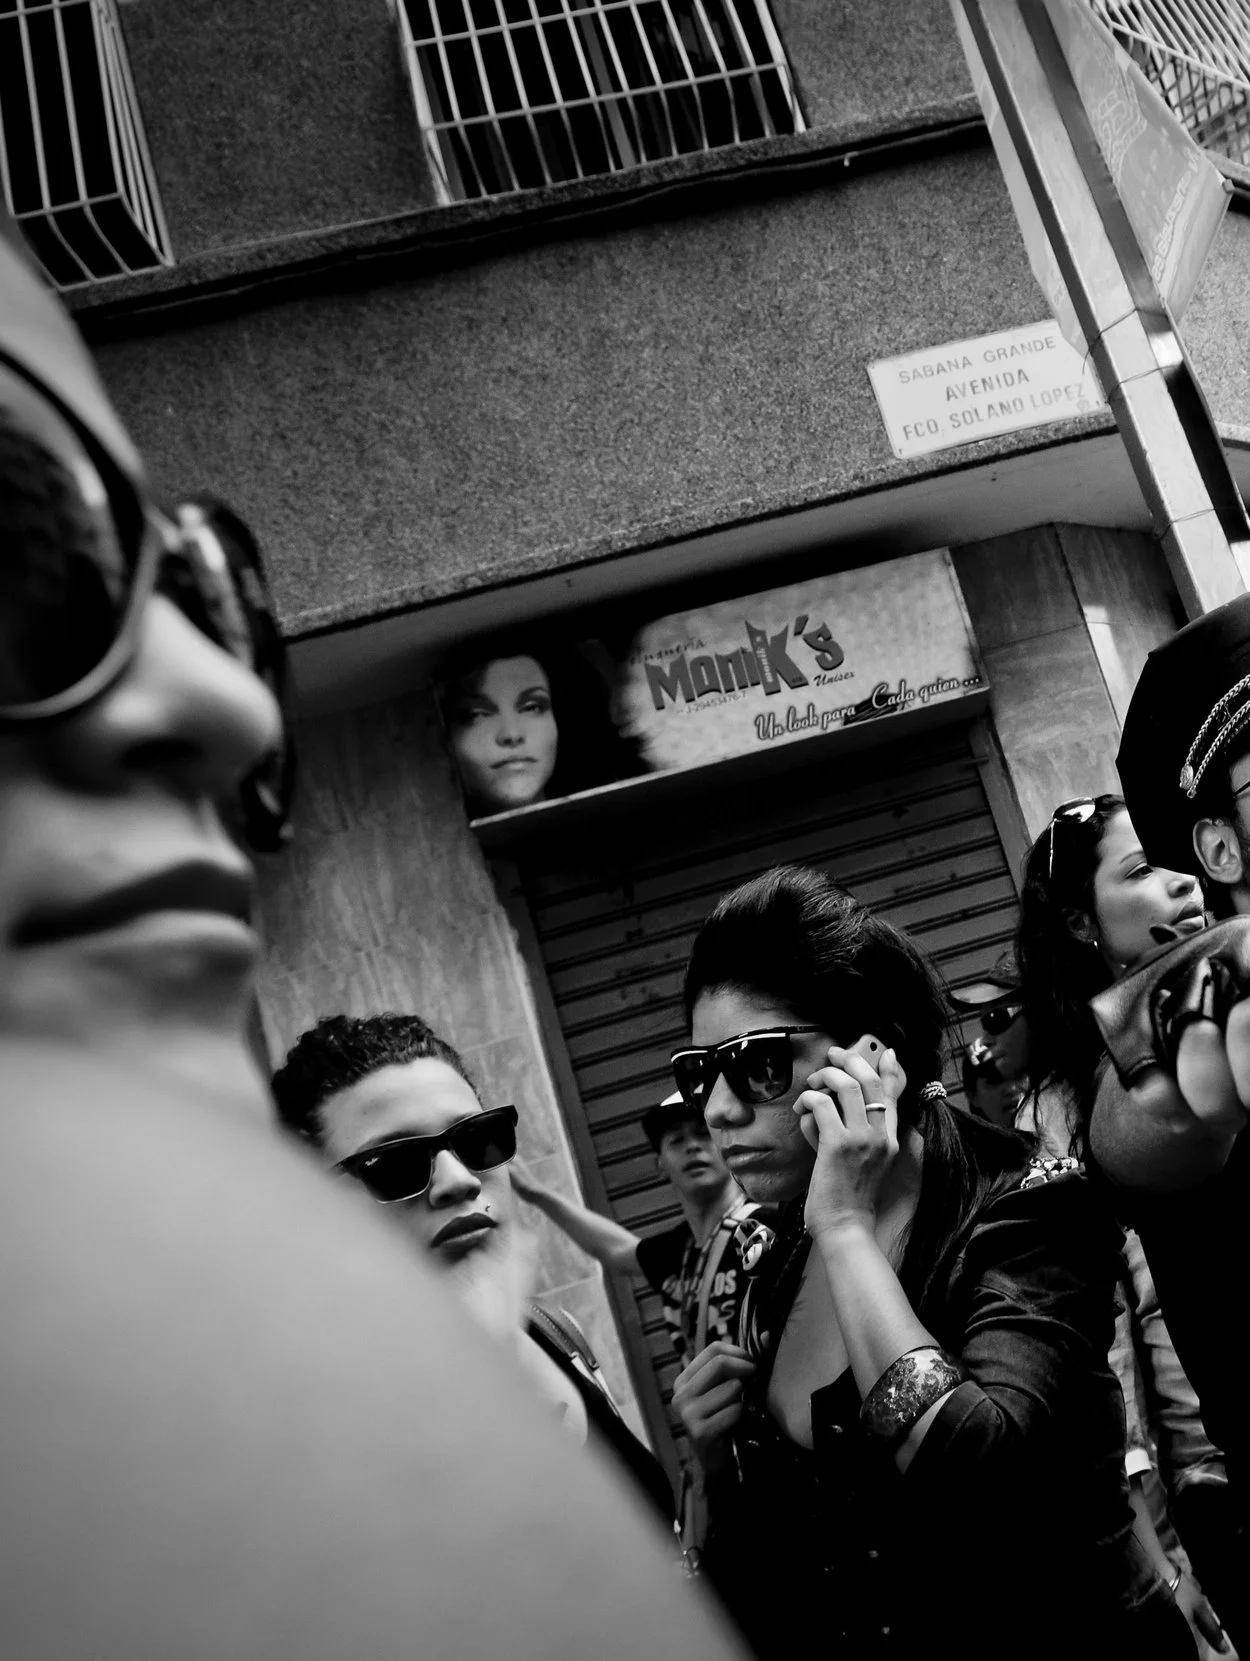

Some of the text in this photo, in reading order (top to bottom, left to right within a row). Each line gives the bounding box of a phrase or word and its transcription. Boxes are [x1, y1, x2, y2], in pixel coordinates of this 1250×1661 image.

[898, 336, 1057, 384] SABANA GRANDE
[945, 368, 1030, 402] AVENIDA
[948, 397, 1025, 429] SOLANO
[1031, 383, 1084, 409] LOPEZ
[813, 670, 857, 688] Unisex
[755, 715, 784, 740] Un
[787, 703, 820, 733] look
[822, 705, 857, 732] para
[871, 681, 914, 710] Cada
[918, 676, 960, 705] quien
